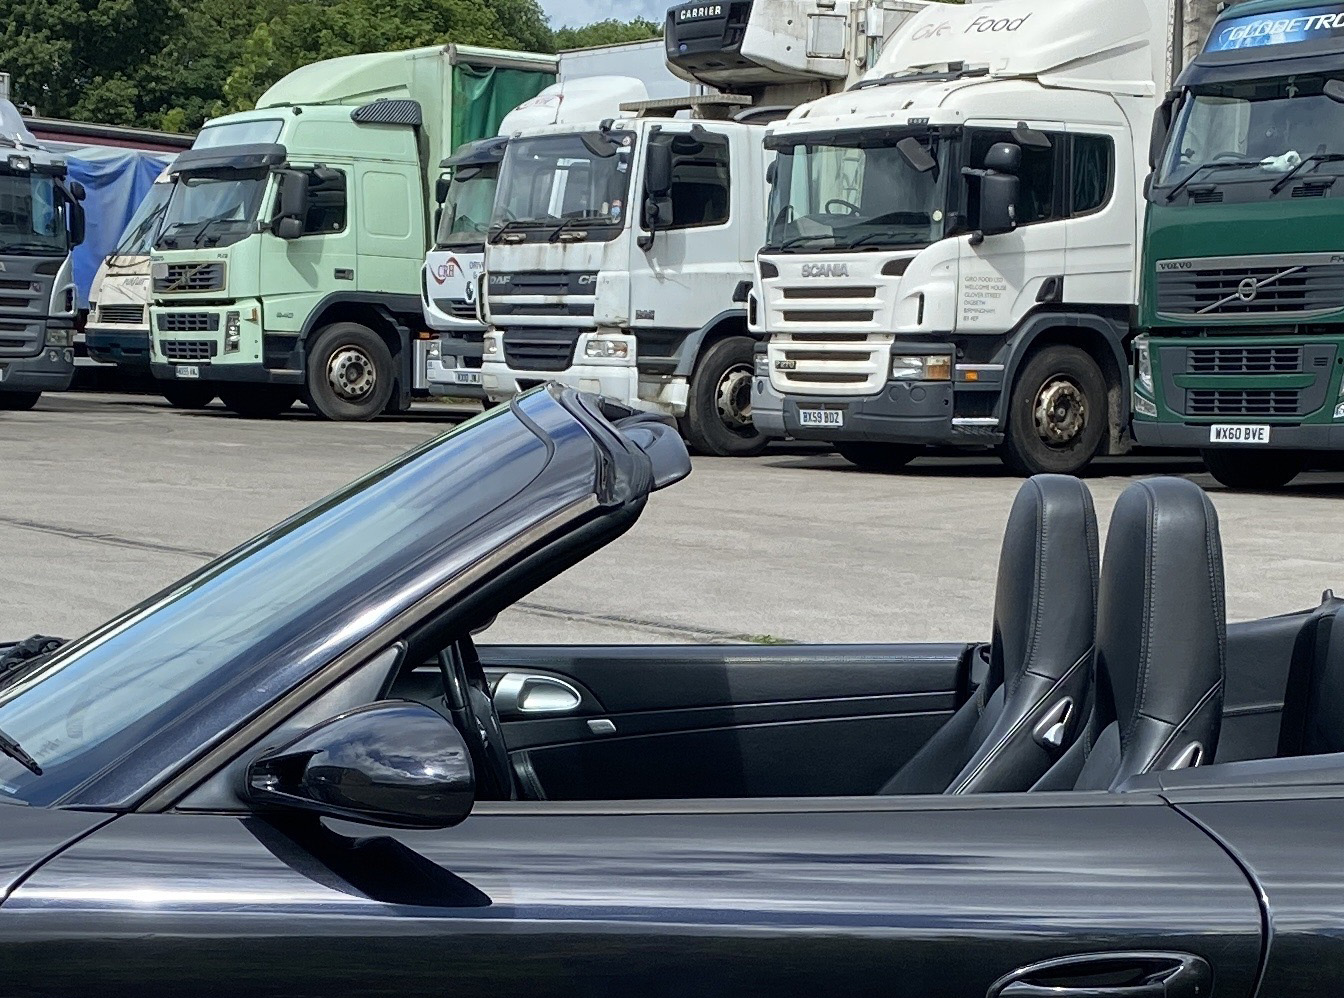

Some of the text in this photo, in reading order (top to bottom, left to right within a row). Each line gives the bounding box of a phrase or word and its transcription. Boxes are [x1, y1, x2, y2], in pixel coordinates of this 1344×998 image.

[680, 6, 722, 19] CARRIER
[964, 12, 1032, 33] Food
[438, 264, 455, 278] CRH
[801, 263, 849, 278] SCANIA
[1159, 261, 1193, 270] VOLVO
[490, 275, 511, 285] DAF
[803, 410, 839, 423] BX59 BDZ
[1215, 427, 1264, 441] WX60 BVE
